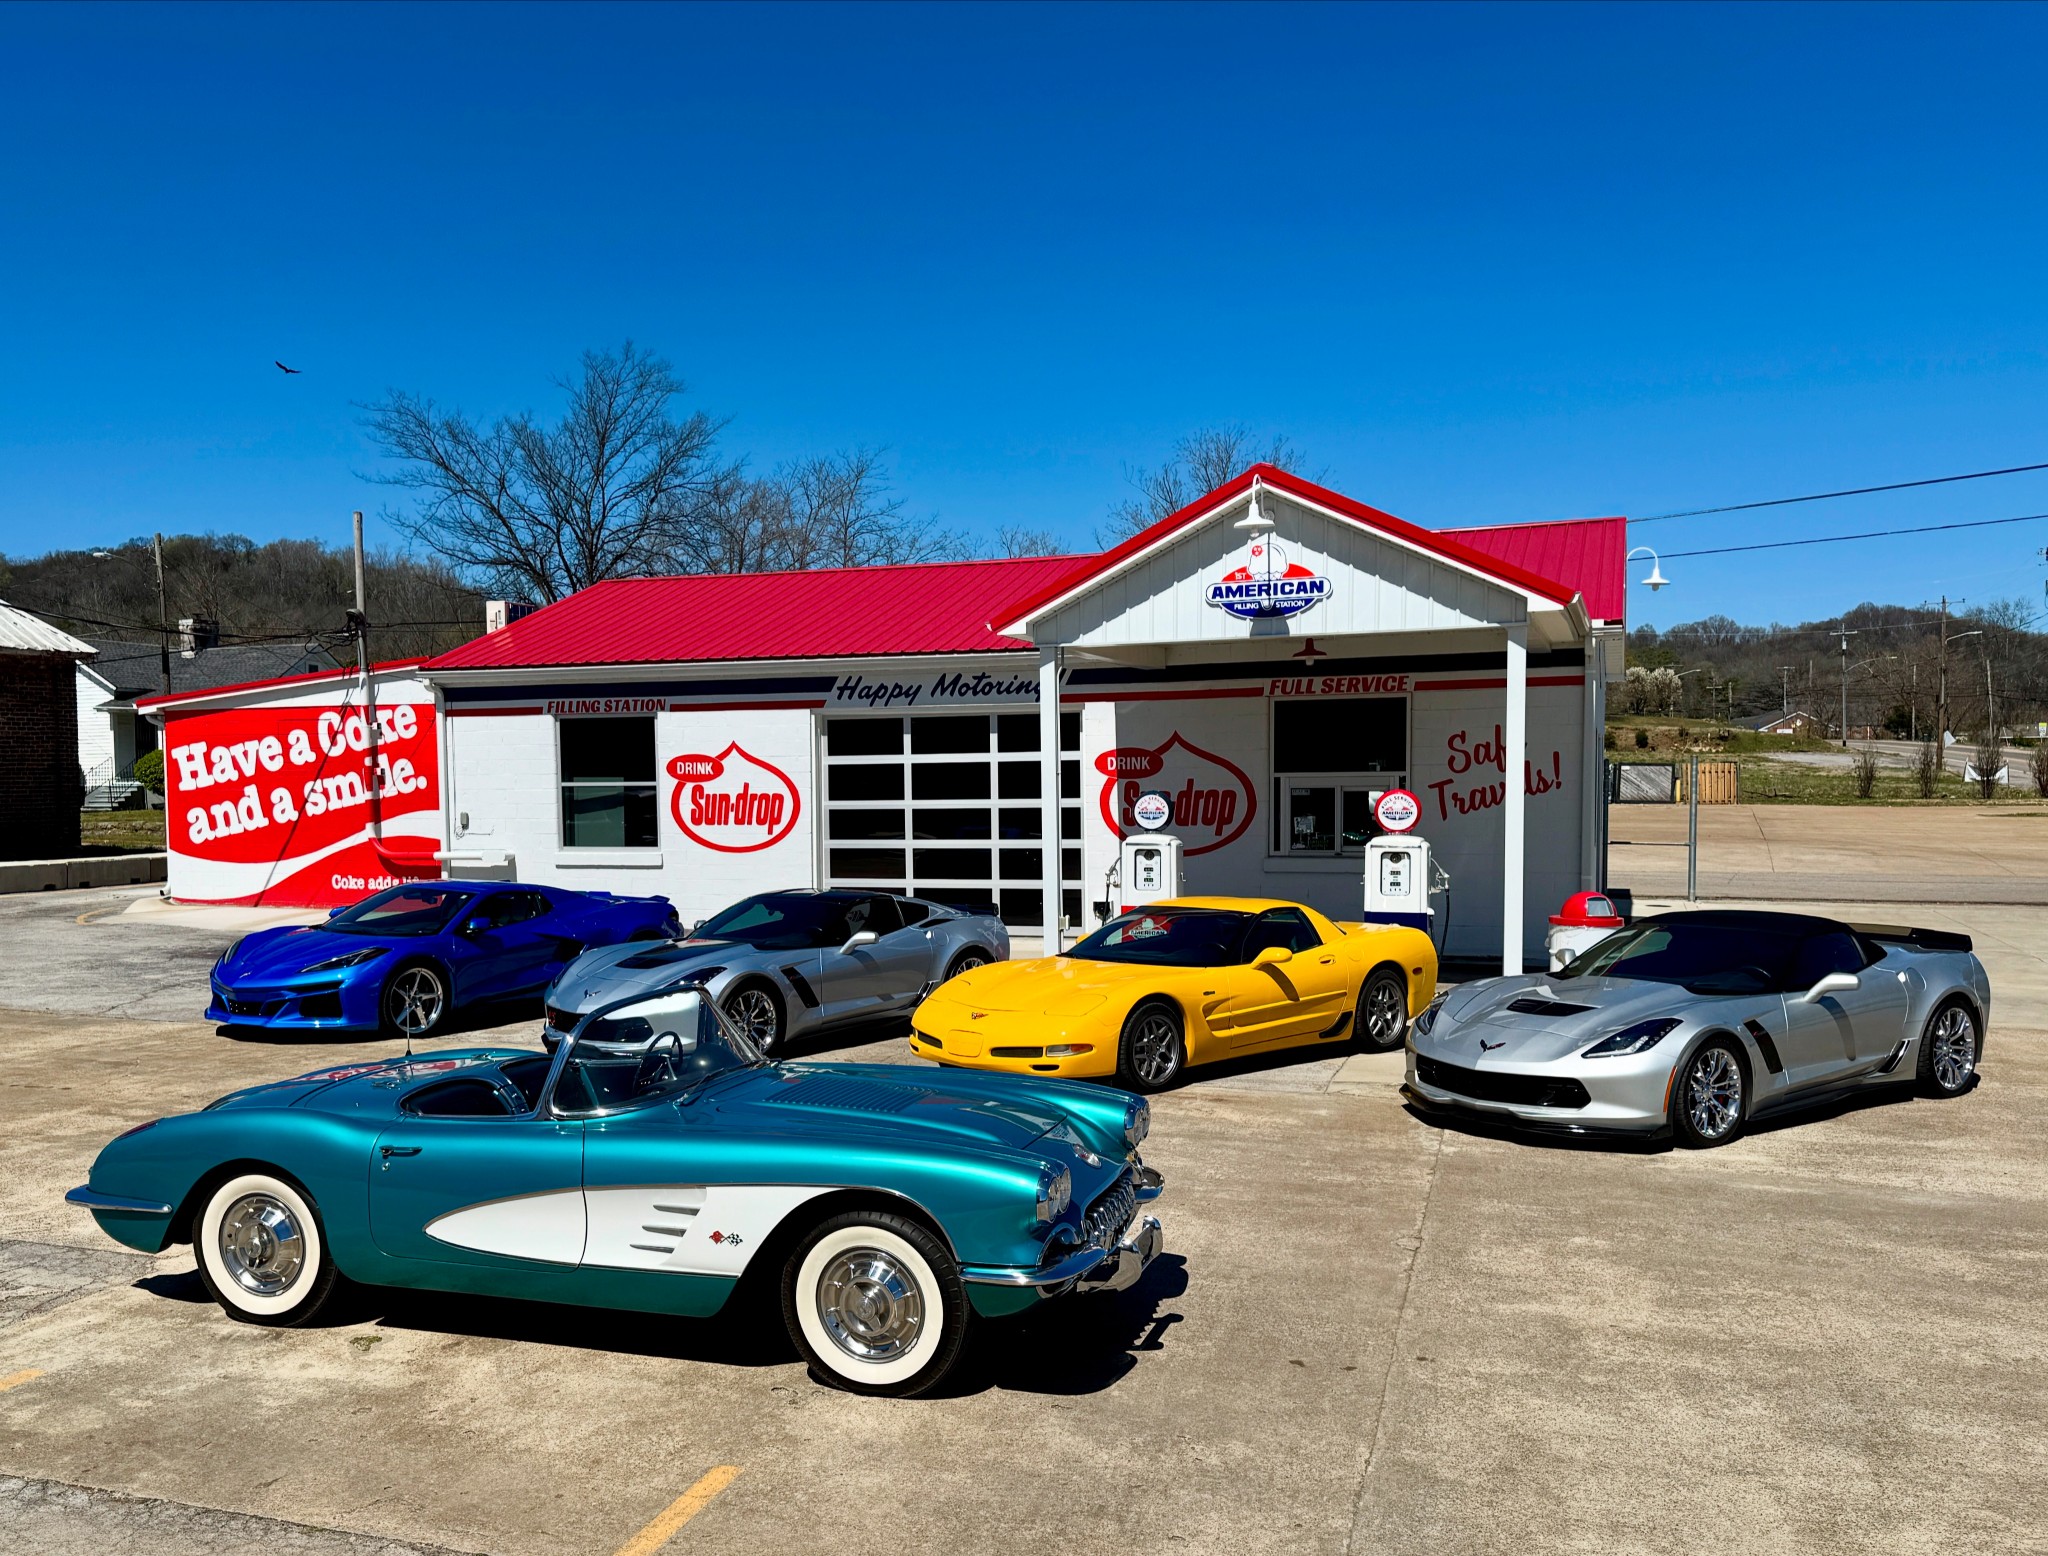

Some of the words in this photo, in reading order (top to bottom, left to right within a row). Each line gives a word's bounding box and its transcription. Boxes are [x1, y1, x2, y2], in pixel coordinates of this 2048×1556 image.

[1235, 572, 1246, 580] 1ST
[1212, 580, 1324, 599] AMERICAN
[1234, 602, 1259, 610] FILLING
[1275, 600, 1305, 608] STATION
[837, 674, 923, 707] Happy
[1269, 678, 1316, 695] FULL
[1320, 675, 1410, 694] SERVICE
[547, 700, 601, 714] FILLING
[603, 698, 667, 713] STATION
[1448, 724, 1527, 773] Saf
[171, 734, 285, 791] Have
[287, 728, 317, 766] a
[676, 761, 714, 775] DRINK
[1107, 756, 1150, 771] DRINK
[1428, 751, 1562, 821] Travls!
[186, 784, 269, 844] and
[270, 787, 299, 824] a
[331, 874, 365, 890] Coke
[368, 876, 400, 890] adds
